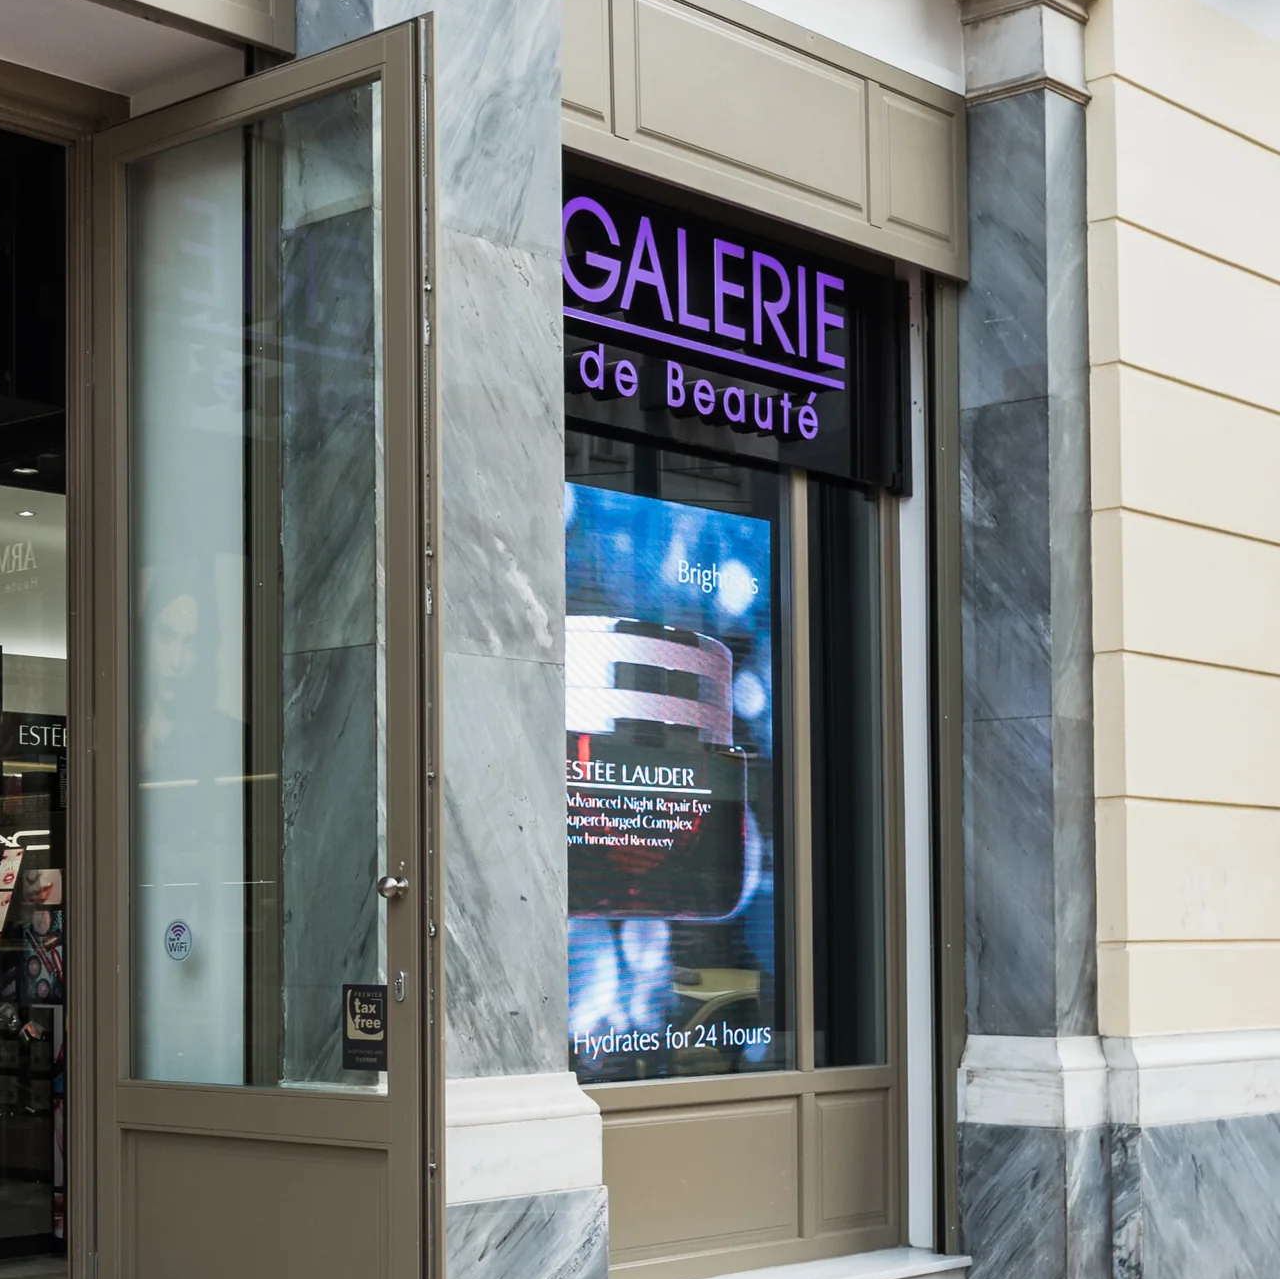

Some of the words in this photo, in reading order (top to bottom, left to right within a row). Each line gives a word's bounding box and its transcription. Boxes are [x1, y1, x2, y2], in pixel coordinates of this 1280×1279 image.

[562, 196, 845, 369] GALERIE
[579, 343, 638, 397] de
[666, 360, 819, 440] Beauté
[622, 764, 695, 787] LAUDER
[623, 796, 653, 813] Night
[656, 798, 690, 816] Repair
[693, 800, 712, 816] Eye
[642, 815, 693, 833] Complex
[631, 834, 675, 850] Recovery
[354, 998, 377, 1015] tax
[354, 1015, 381, 1031] free
[573, 1027, 660, 1060] Hydrates
[665, 1024, 691, 1050] for
[694, 1024, 718, 1048] 24
[722, 1021, 771, 1046] hours
